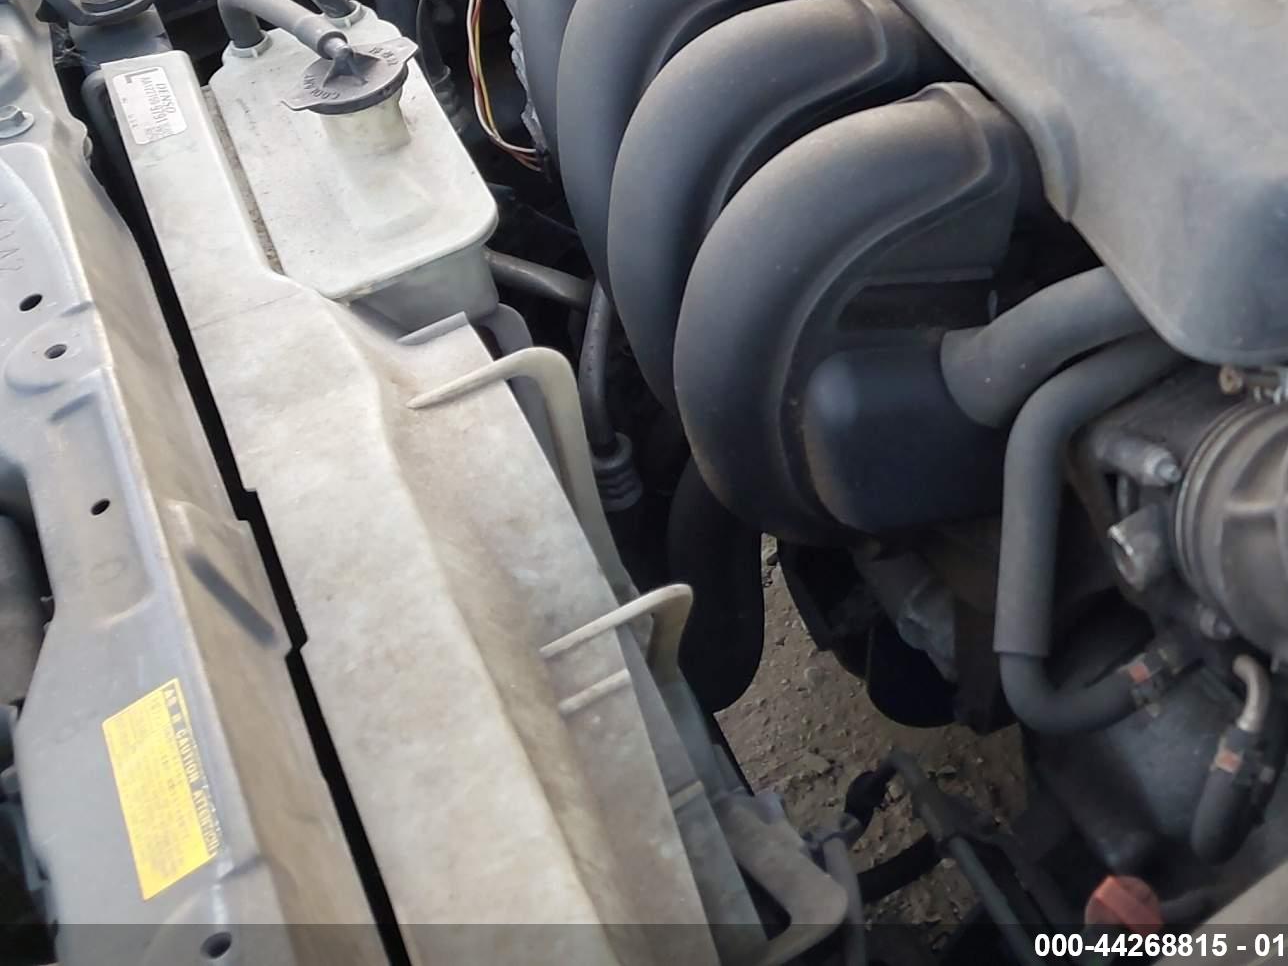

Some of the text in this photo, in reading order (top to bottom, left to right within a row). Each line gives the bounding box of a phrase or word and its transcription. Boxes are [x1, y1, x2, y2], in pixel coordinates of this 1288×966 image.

[155, 82, 177, 115] DENSO
[175, 727, 220, 852] CAUTION ATTENTION
